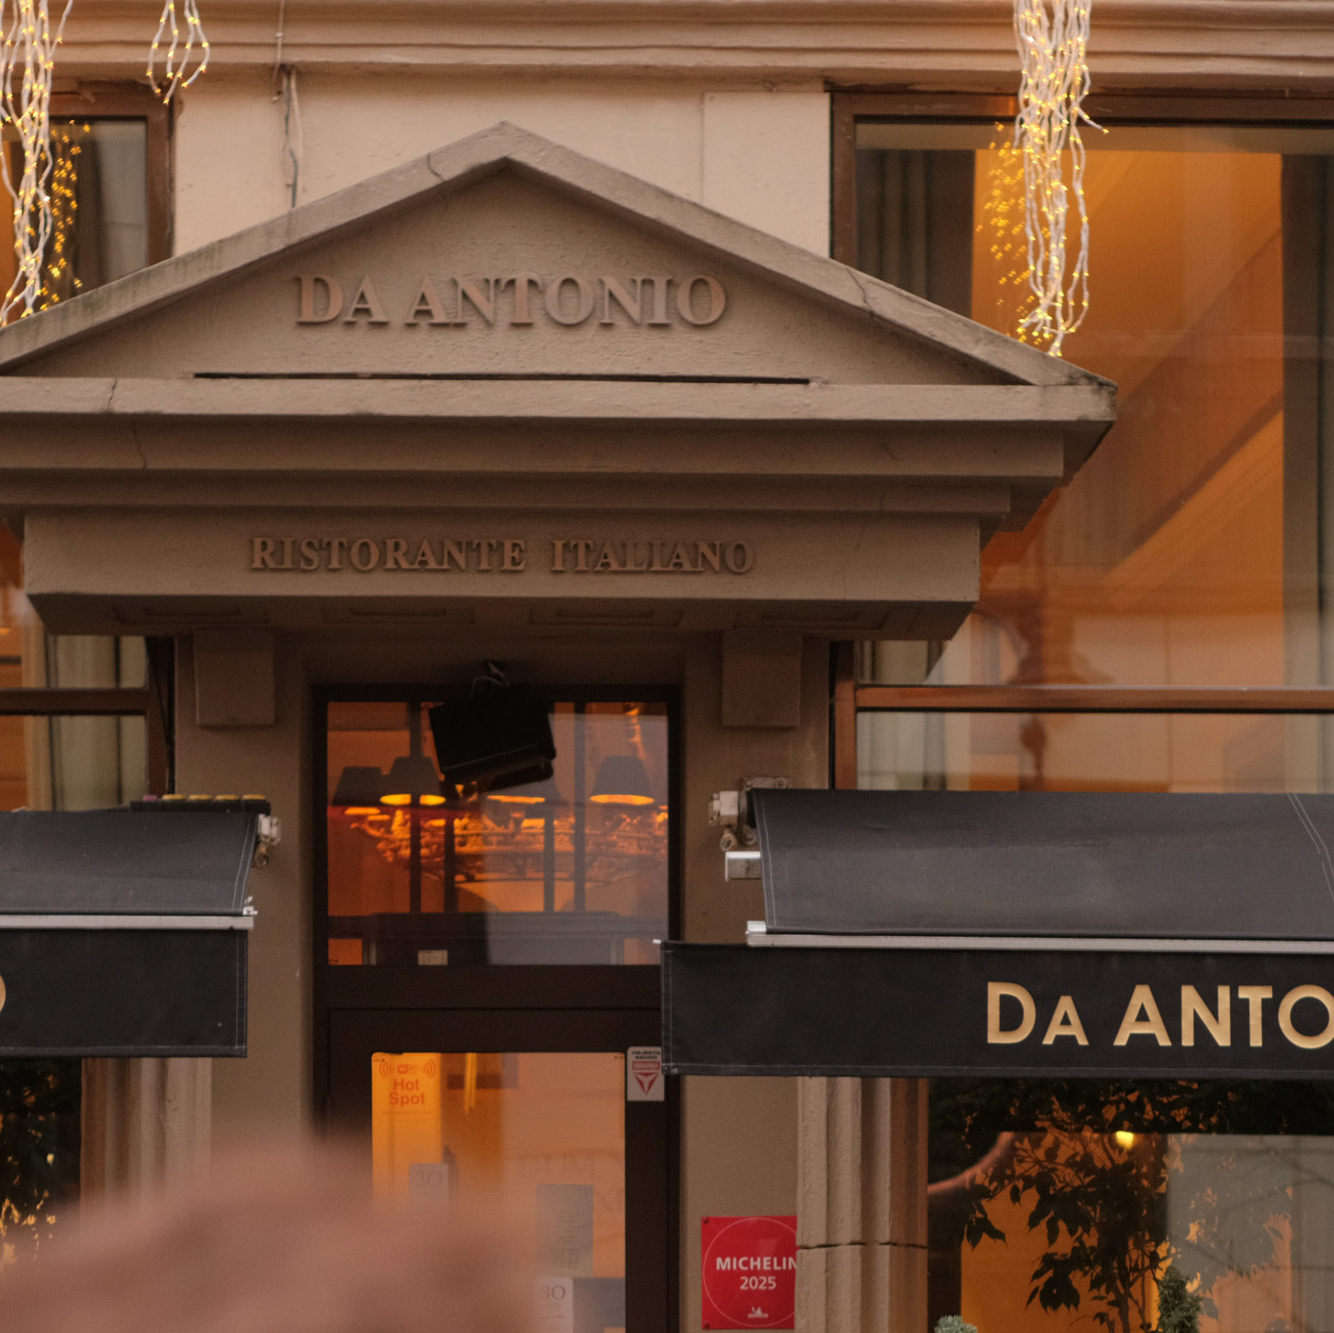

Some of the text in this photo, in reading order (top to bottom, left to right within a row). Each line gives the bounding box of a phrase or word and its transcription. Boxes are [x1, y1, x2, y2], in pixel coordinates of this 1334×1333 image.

[295, 274, 727, 328] DA ANTONIO
[249, 536, 756, 575] RISTORANTE ITALIANO
[986, 981, 1090, 1046] DA
[393, 1078, 420, 1091] Hot
[388, 1092, 426, 1107] Spot
[716, 1256, 796, 1271] MICHELIN
[739, 1275, 777, 1290] 2025
